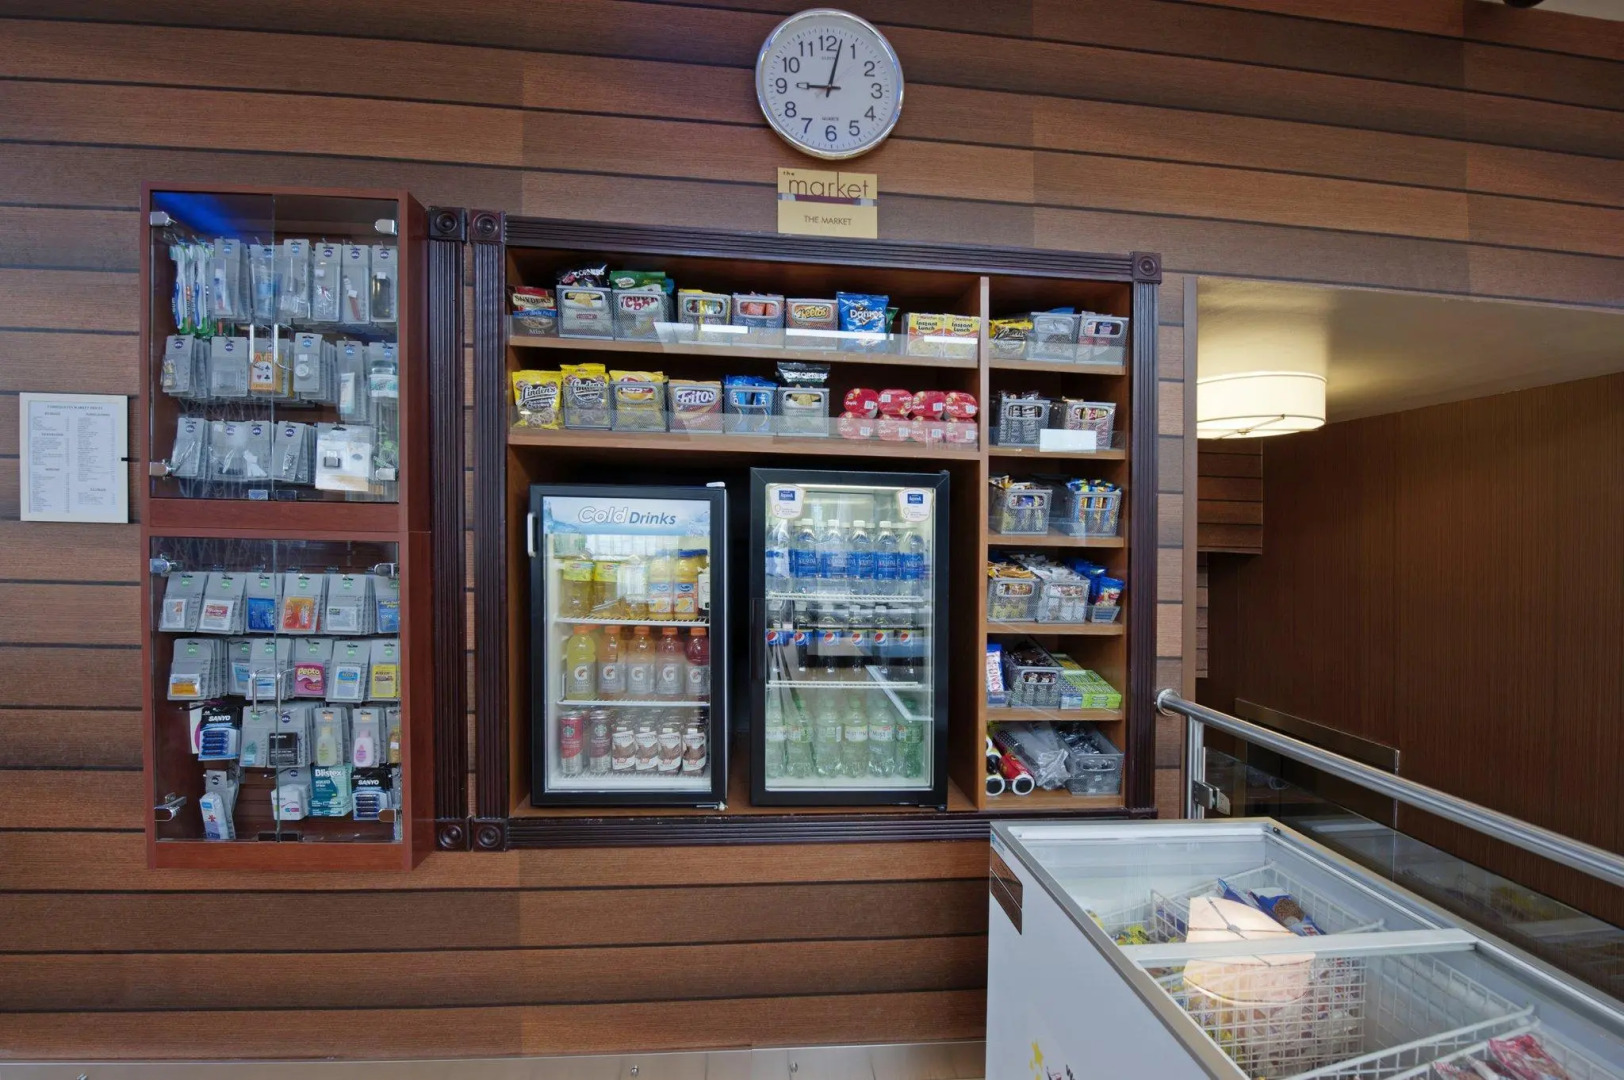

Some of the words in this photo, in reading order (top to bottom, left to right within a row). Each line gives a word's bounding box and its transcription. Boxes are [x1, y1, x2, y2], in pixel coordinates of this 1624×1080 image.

[798, 41, 814, 57] 11
[818, 35, 838, 52] 12
[850, 43, 856, 59] 1
[782, 56, 800, 73] 10
[863, 60, 876, 77] 2
[775, 77, 788, 95] 9
[870, 82, 883, 99] 3
[784, 101, 797, 118] 8
[864, 105, 877, 121] 4
[800, 117, 813, 134] 7
[825, 125, 837, 142] 6
[849, 120, 860, 136] 5
[788, 172, 869, 199] market
[804, 215, 820, 224] THE
[821, 216, 852, 226] MARKET
[676, 389, 715, 405] Fritos
[578, 505, 629, 524] Cold
[629, 511, 677, 525] Drinks
[314, 768, 342, 777] Blistex
